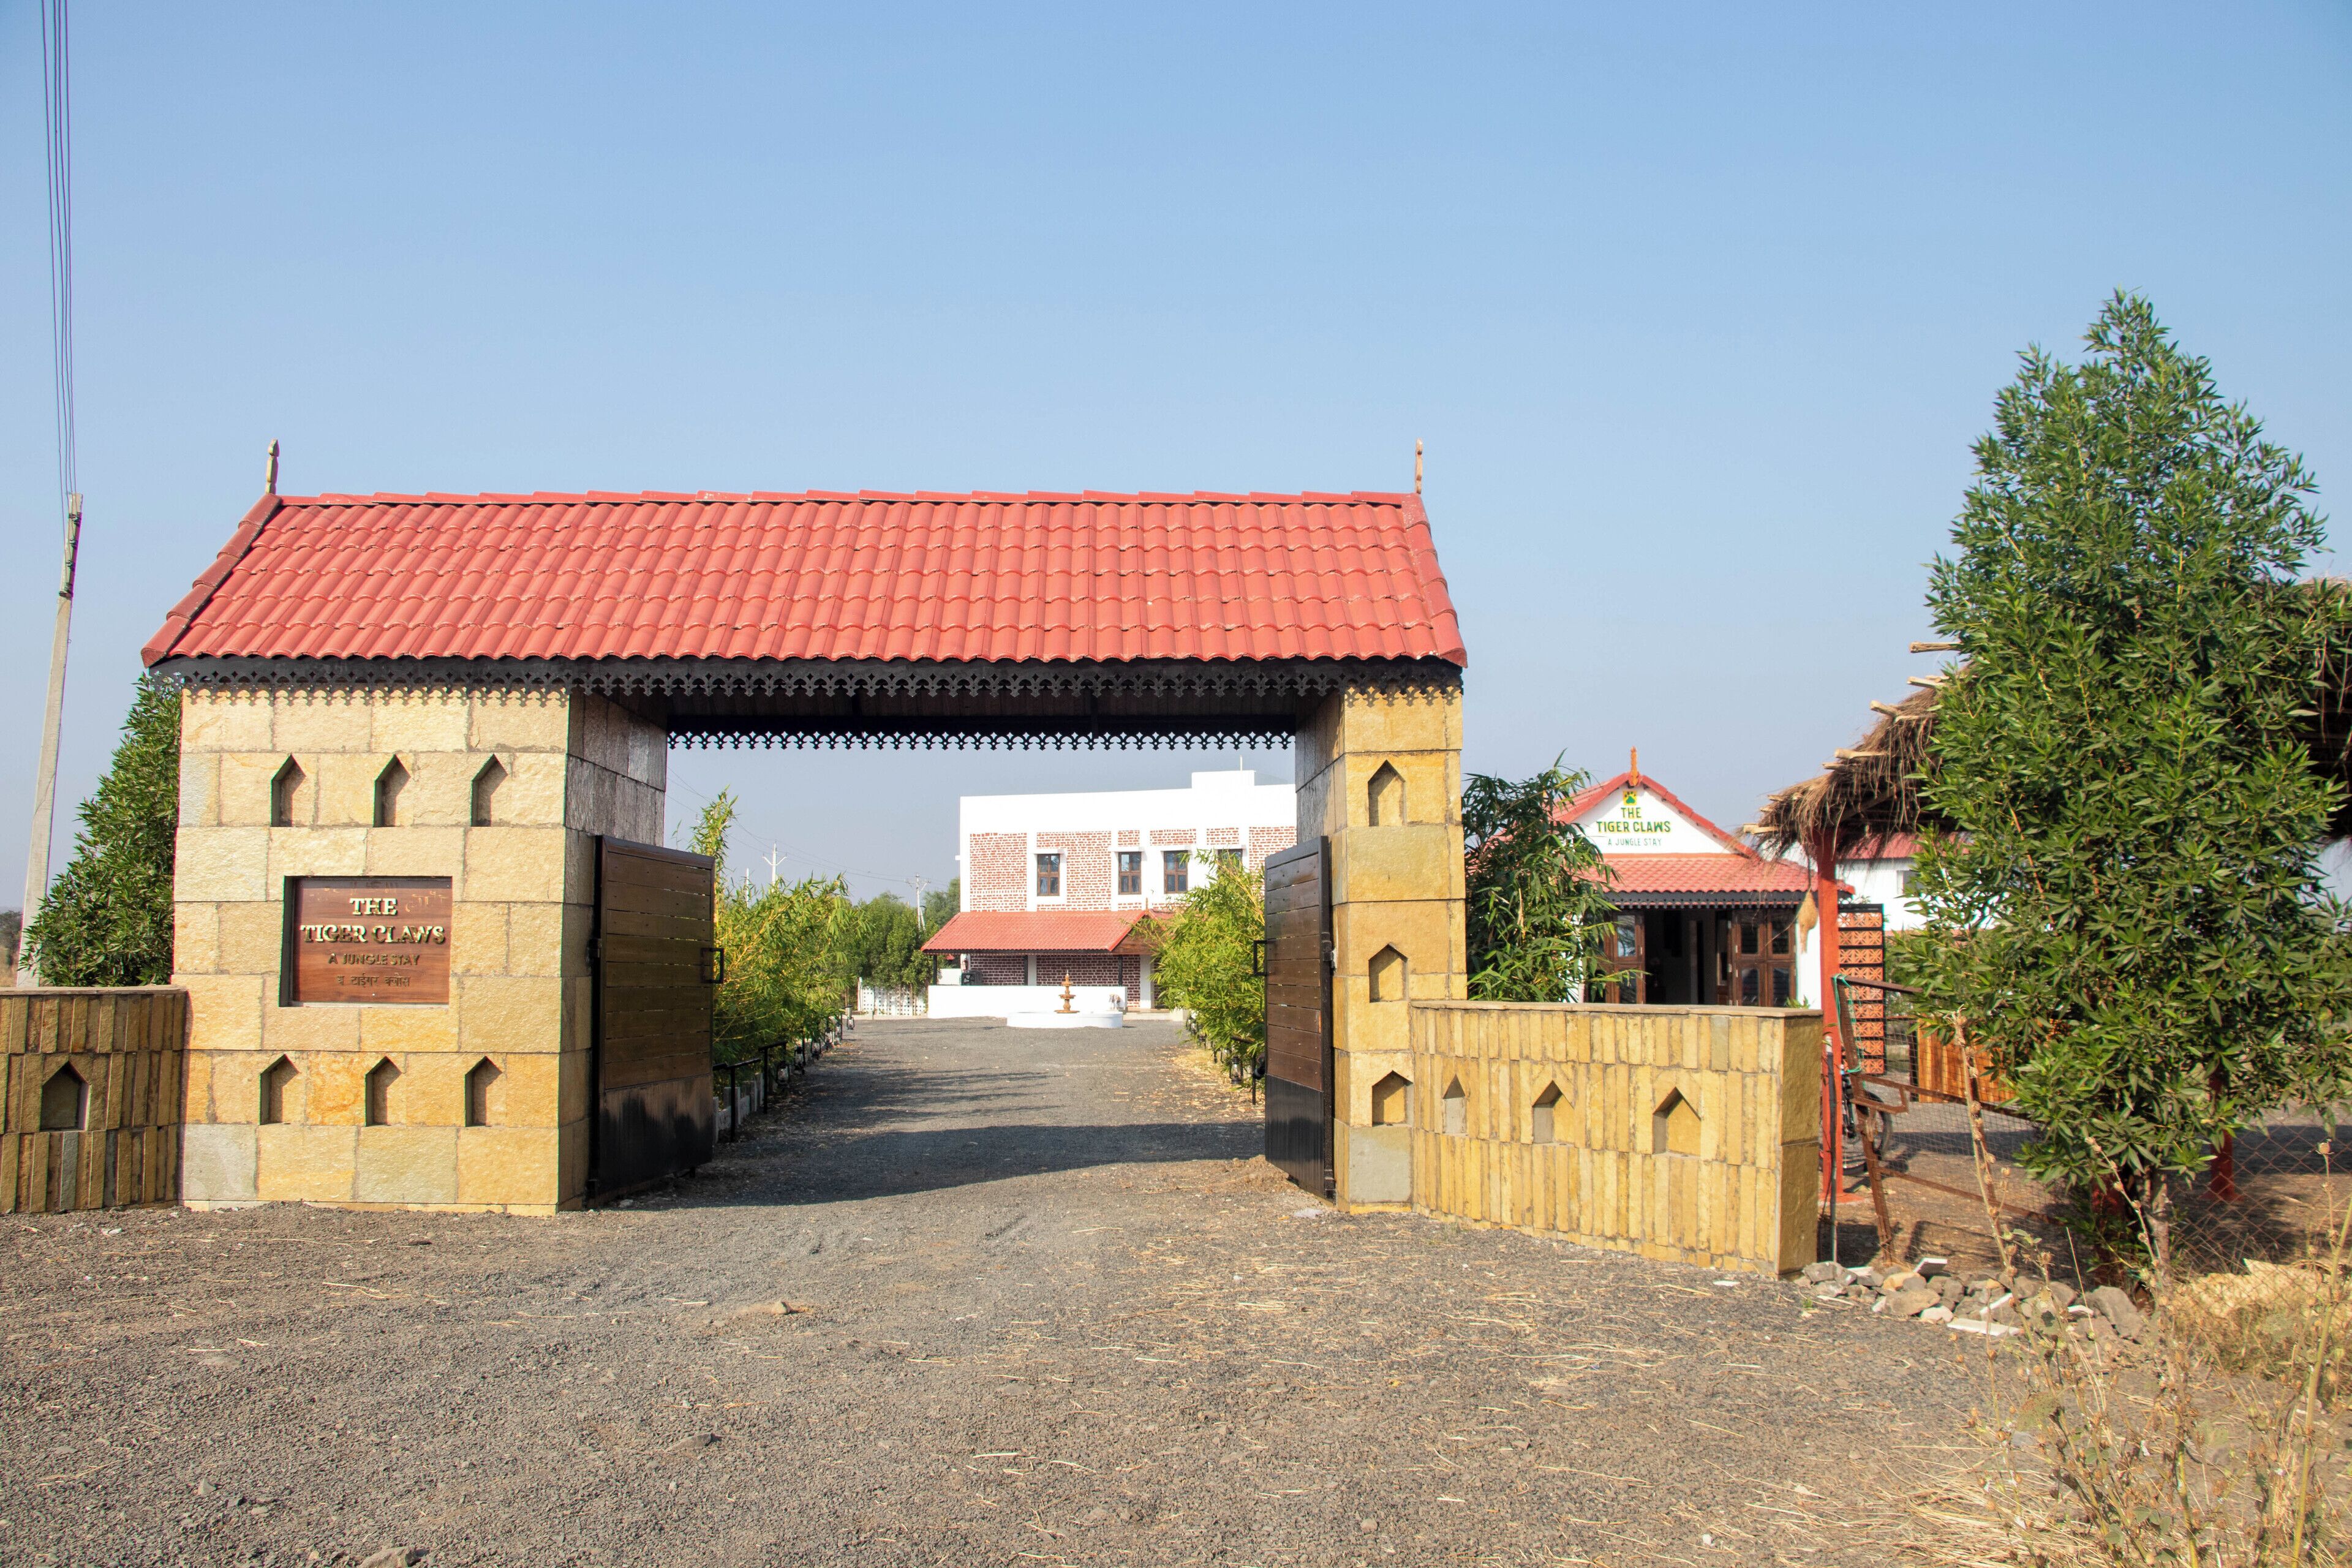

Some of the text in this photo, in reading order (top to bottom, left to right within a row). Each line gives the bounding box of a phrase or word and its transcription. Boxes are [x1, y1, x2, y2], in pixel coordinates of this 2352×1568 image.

[1621, 807, 1642, 818] THE
[1596, 821, 1671, 832] TIGER CLAWS
[350, 897, 397, 915] THE
[300, 924, 446, 943] TIGER CLAWS
[328, 953, 420, 965] A JUNGLE STAY
